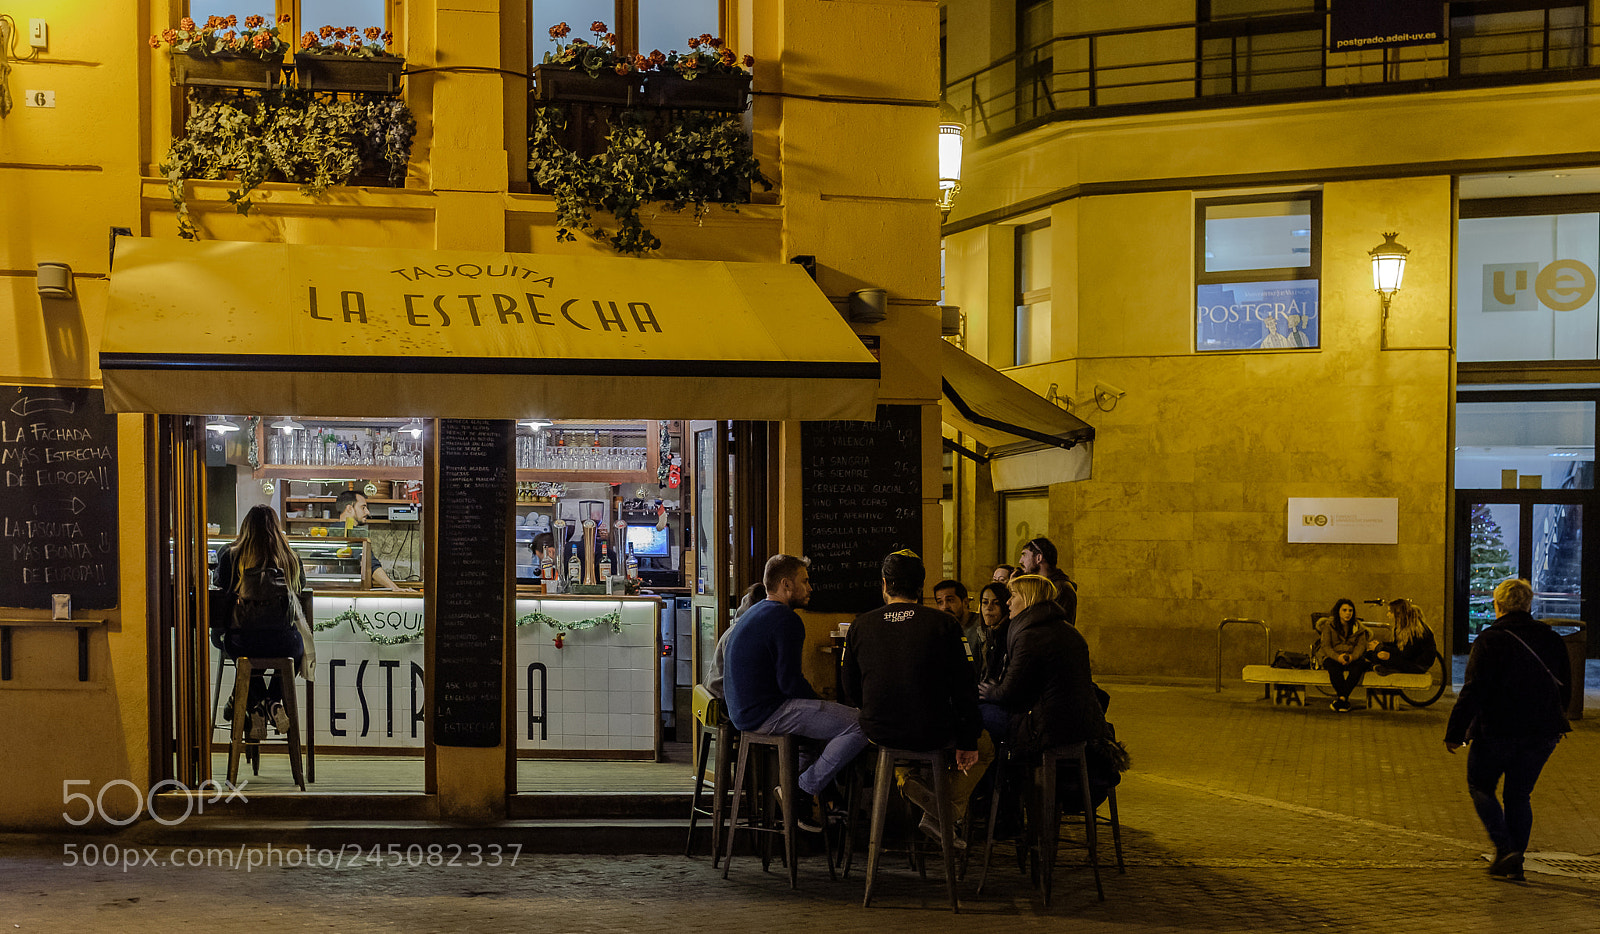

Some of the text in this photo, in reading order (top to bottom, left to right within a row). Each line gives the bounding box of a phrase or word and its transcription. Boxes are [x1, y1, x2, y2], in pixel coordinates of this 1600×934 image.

[1336, 32, 1437, 49] postgrado.adeit-uv.es
[34, 92, 46, 106] 6
[391, 263, 556, 289] TASQUITA
[308, 286, 663, 333] LA ESTRECHA
[2, 421, 93, 443] LA FACHADA
[832, 436, 875, 447] VALENCIA
[45, 446, 112, 464] ESTRECHA
[830, 469, 869, 478] SIEMPRE
[349, 611, 423, 634] ASQUI
